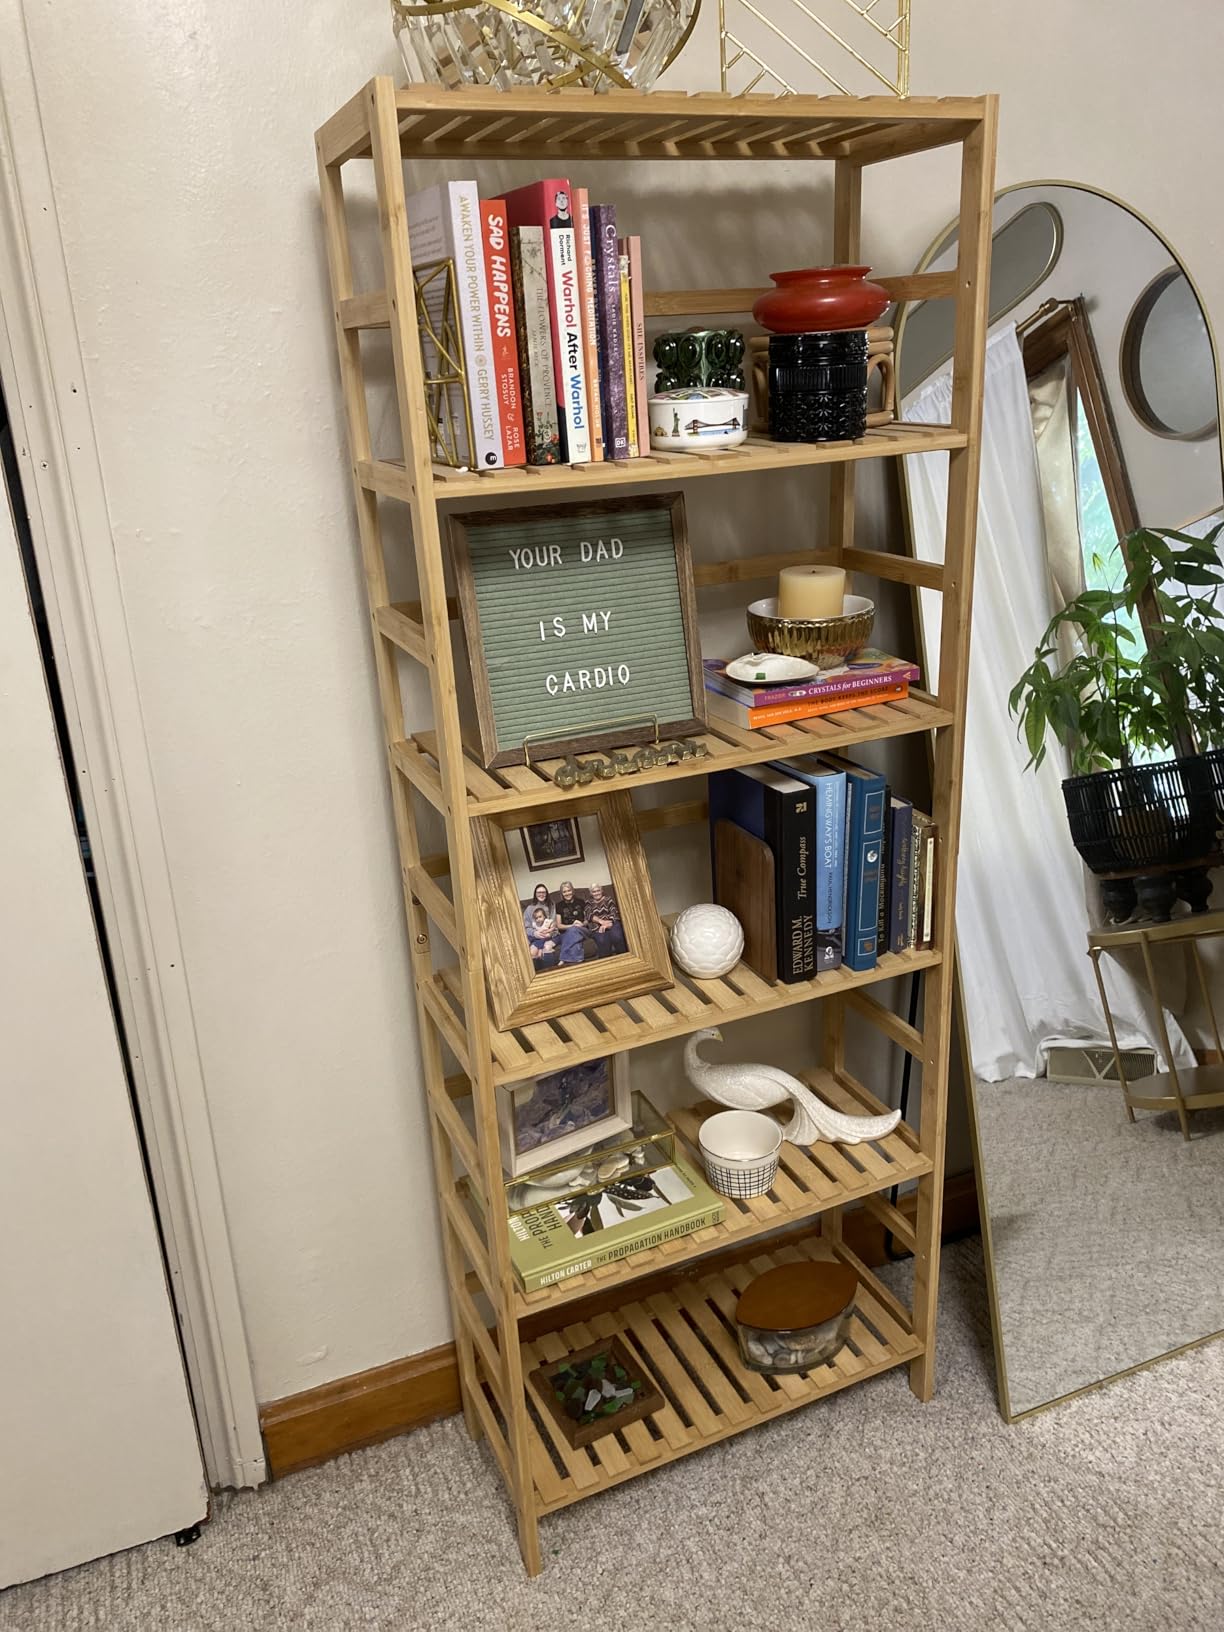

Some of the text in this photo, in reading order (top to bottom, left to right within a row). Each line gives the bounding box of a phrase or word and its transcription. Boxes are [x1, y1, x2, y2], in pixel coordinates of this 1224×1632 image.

[488, 214, 511, 337] SAD HAPPENS
[604, 224, 618, 292] Crystals
[459, 196, 494, 440] AWAKEN YOUR POWER WITHIN GERRY HUSSEY
[587, 298, 596, 346] MEDITATION
[538, 306, 546, 346] FLOWERS
[542, 364, 552, 406] PROVENCE
[562, 270, 585, 429] Warhol After Warhol
[501, 374, 509, 405] STOSUY
[508, 368, 516, 409] BRANDON
[506, 426, 514, 451] LAZAR
[508, 538, 624, 570] YOUR DAD
[540, 611, 611, 641] IS MY
[546, 665, 630, 696] CARDIO
[808, 684, 842, 695] CRYSTALS
[842, 683, 851, 691] for
[852, 675, 892, 688] BEGINNERS
[824, 782, 833, 868] HEMINGWAY'S BOAT
[796, 836, 808, 900] True Compass
[792, 916, 803, 974] EDWARD M.
[803, 915, 813, 972] KENNEDY
[878, 934, 884, 942] To
[538, 1236, 552, 1249] THE
[596, 1218, 706, 1264] THE PROPAGATION HANDBOOK
[540, 1260, 592, 1285] HILTON CARTER
